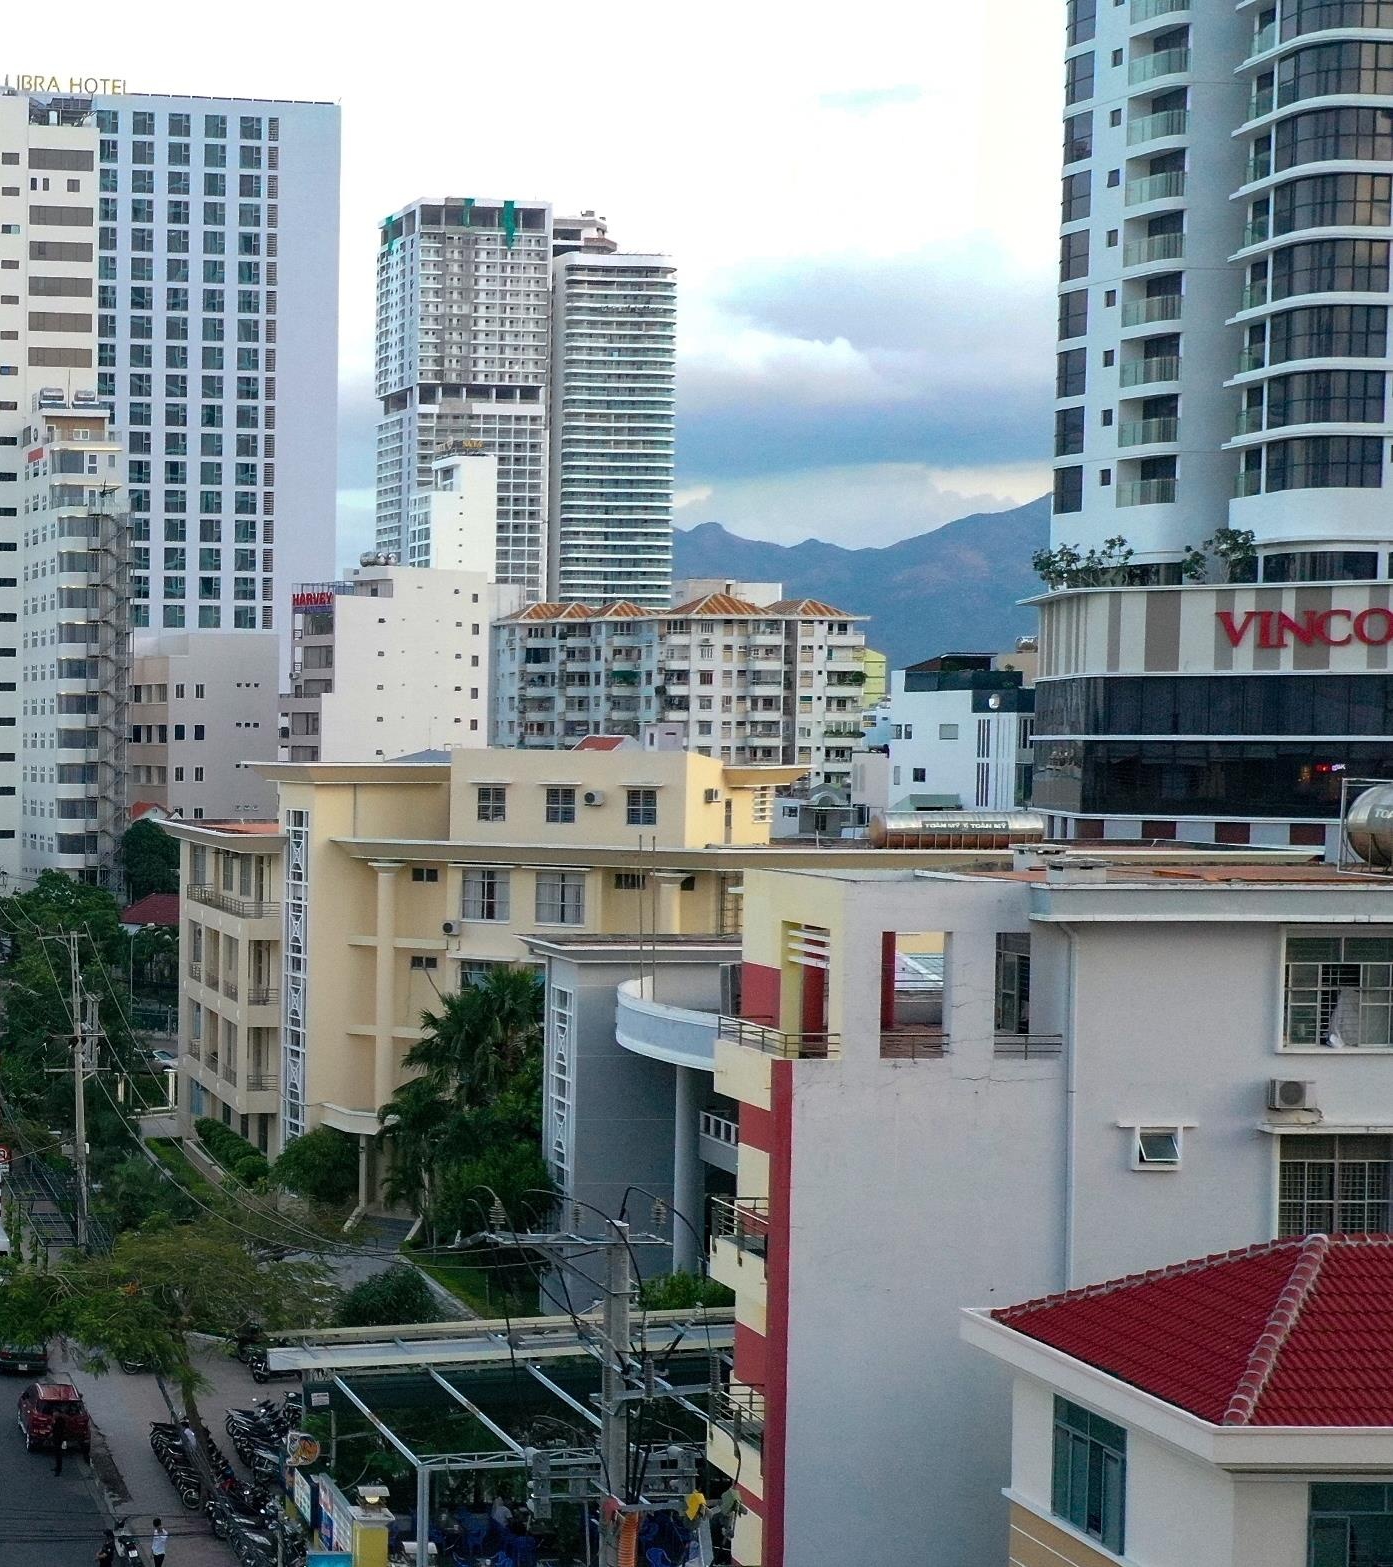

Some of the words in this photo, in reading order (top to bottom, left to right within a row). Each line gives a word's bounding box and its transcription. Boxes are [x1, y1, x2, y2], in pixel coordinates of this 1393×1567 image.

[69, 77, 130, 95] HOTEL
[292, 591, 333, 606] HARVEY
[1214, 608, 1393, 648] VINCO
